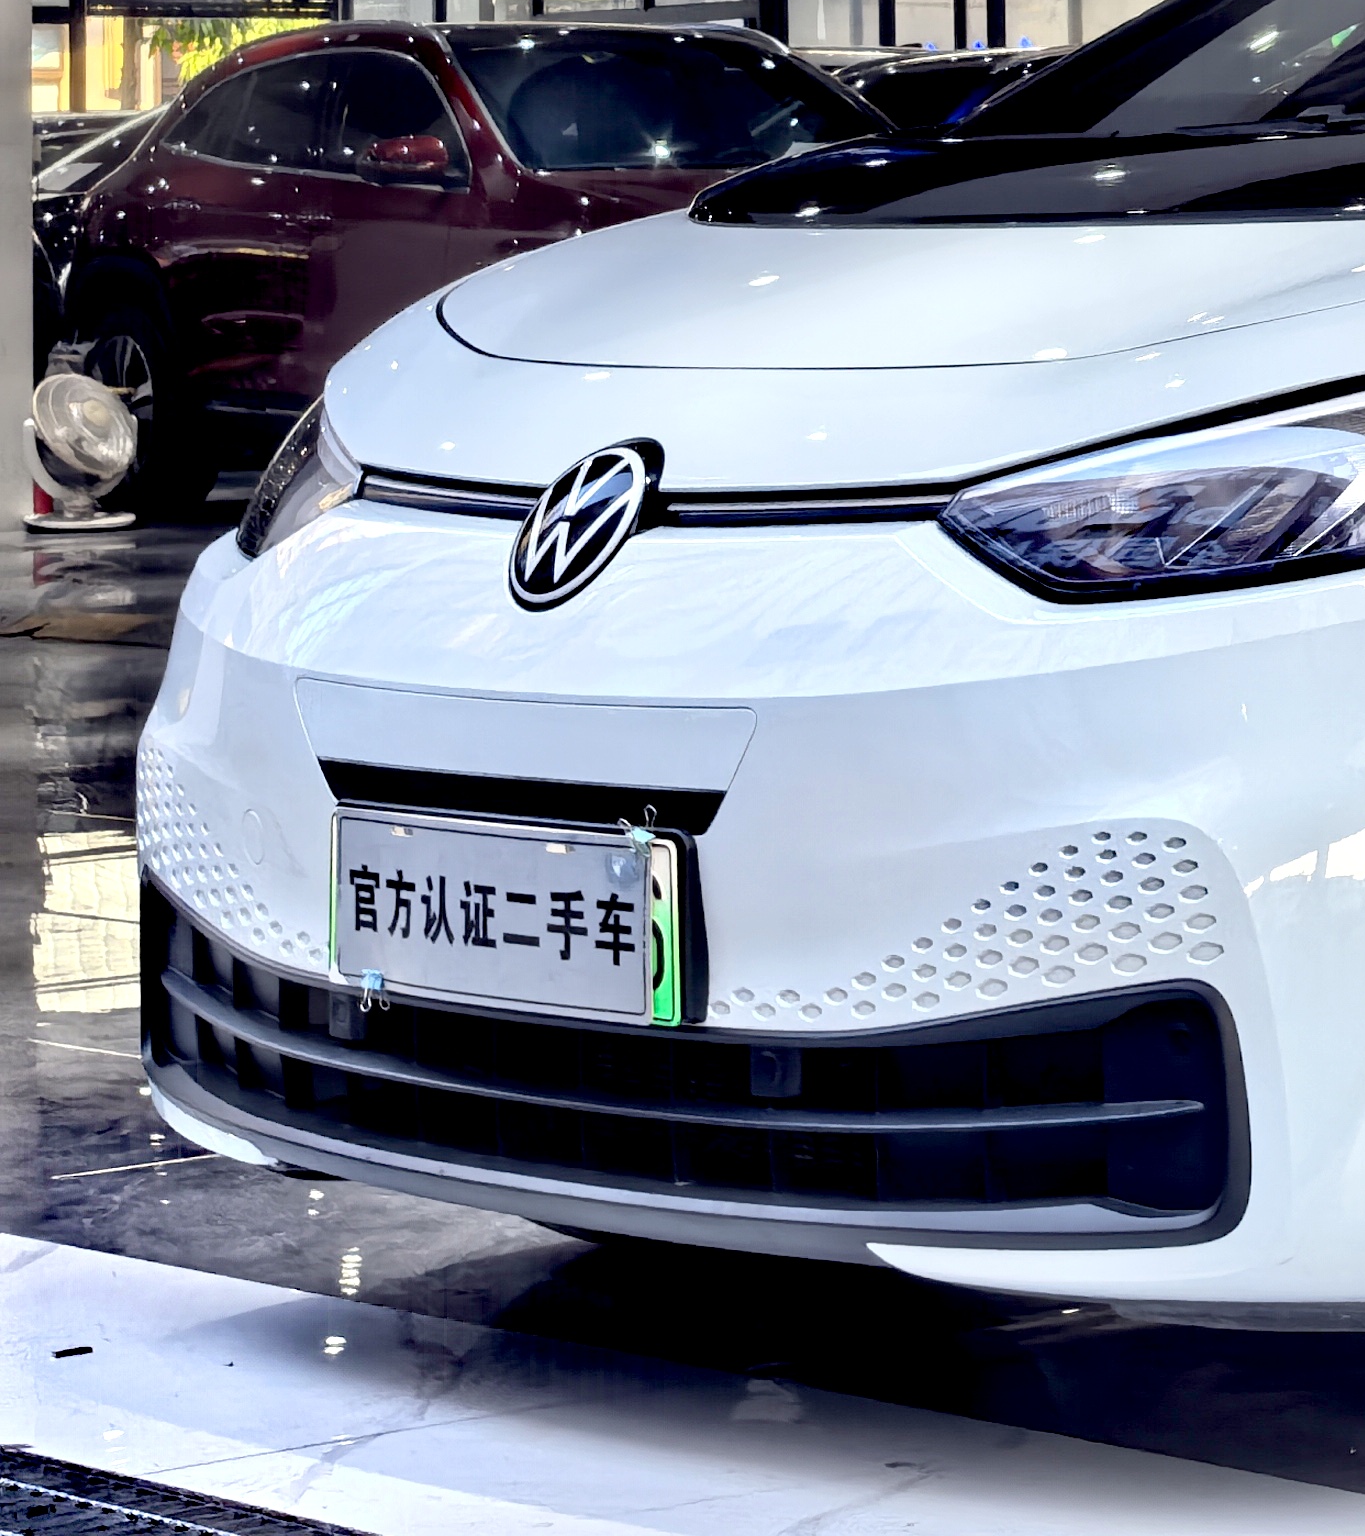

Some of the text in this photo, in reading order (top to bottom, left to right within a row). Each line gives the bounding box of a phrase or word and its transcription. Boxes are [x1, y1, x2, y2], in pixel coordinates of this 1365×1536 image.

[349, 864, 636, 966] 官方认证二手车
